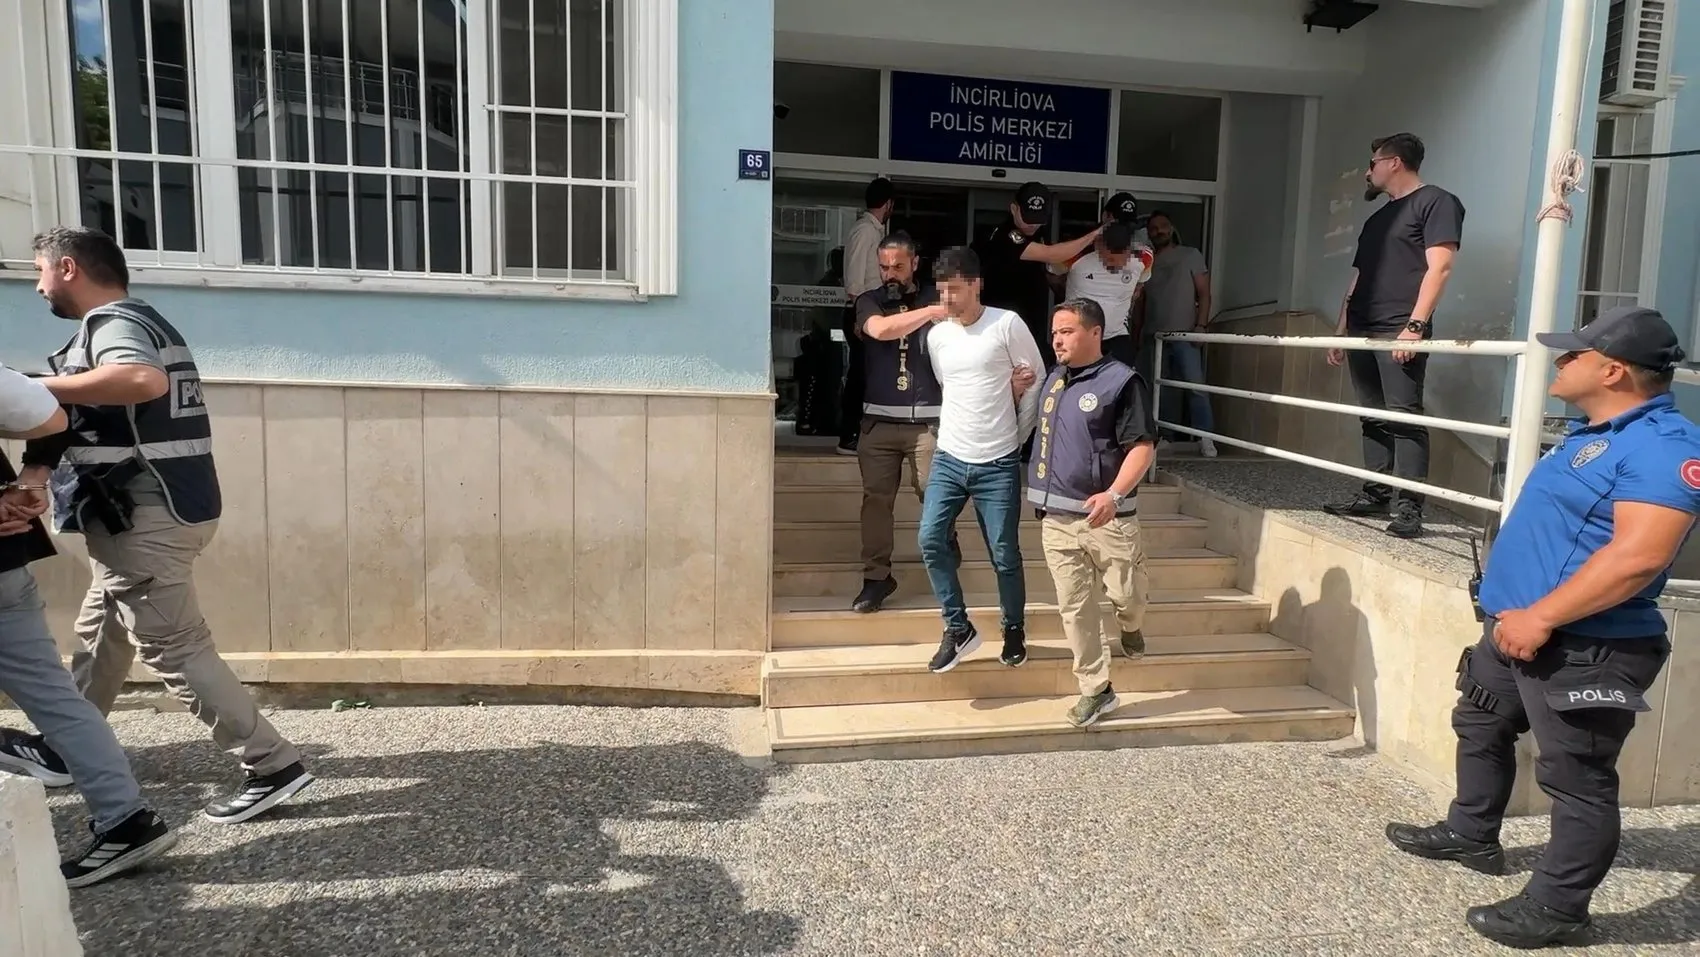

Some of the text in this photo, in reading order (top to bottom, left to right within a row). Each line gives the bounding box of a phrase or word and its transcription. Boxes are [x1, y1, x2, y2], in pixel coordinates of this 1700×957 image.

[950, 82, 1056, 112] İNCİRLİOVA
[929, 111, 1073, 140] POLİS MERKEZİ
[747, 154, 763, 168] 65
[958, 139, 1042, 164] AMİRLİĞİ
[897, 304, 909, 391] PLİS
[1037, 379, 1065, 479] POLİS
